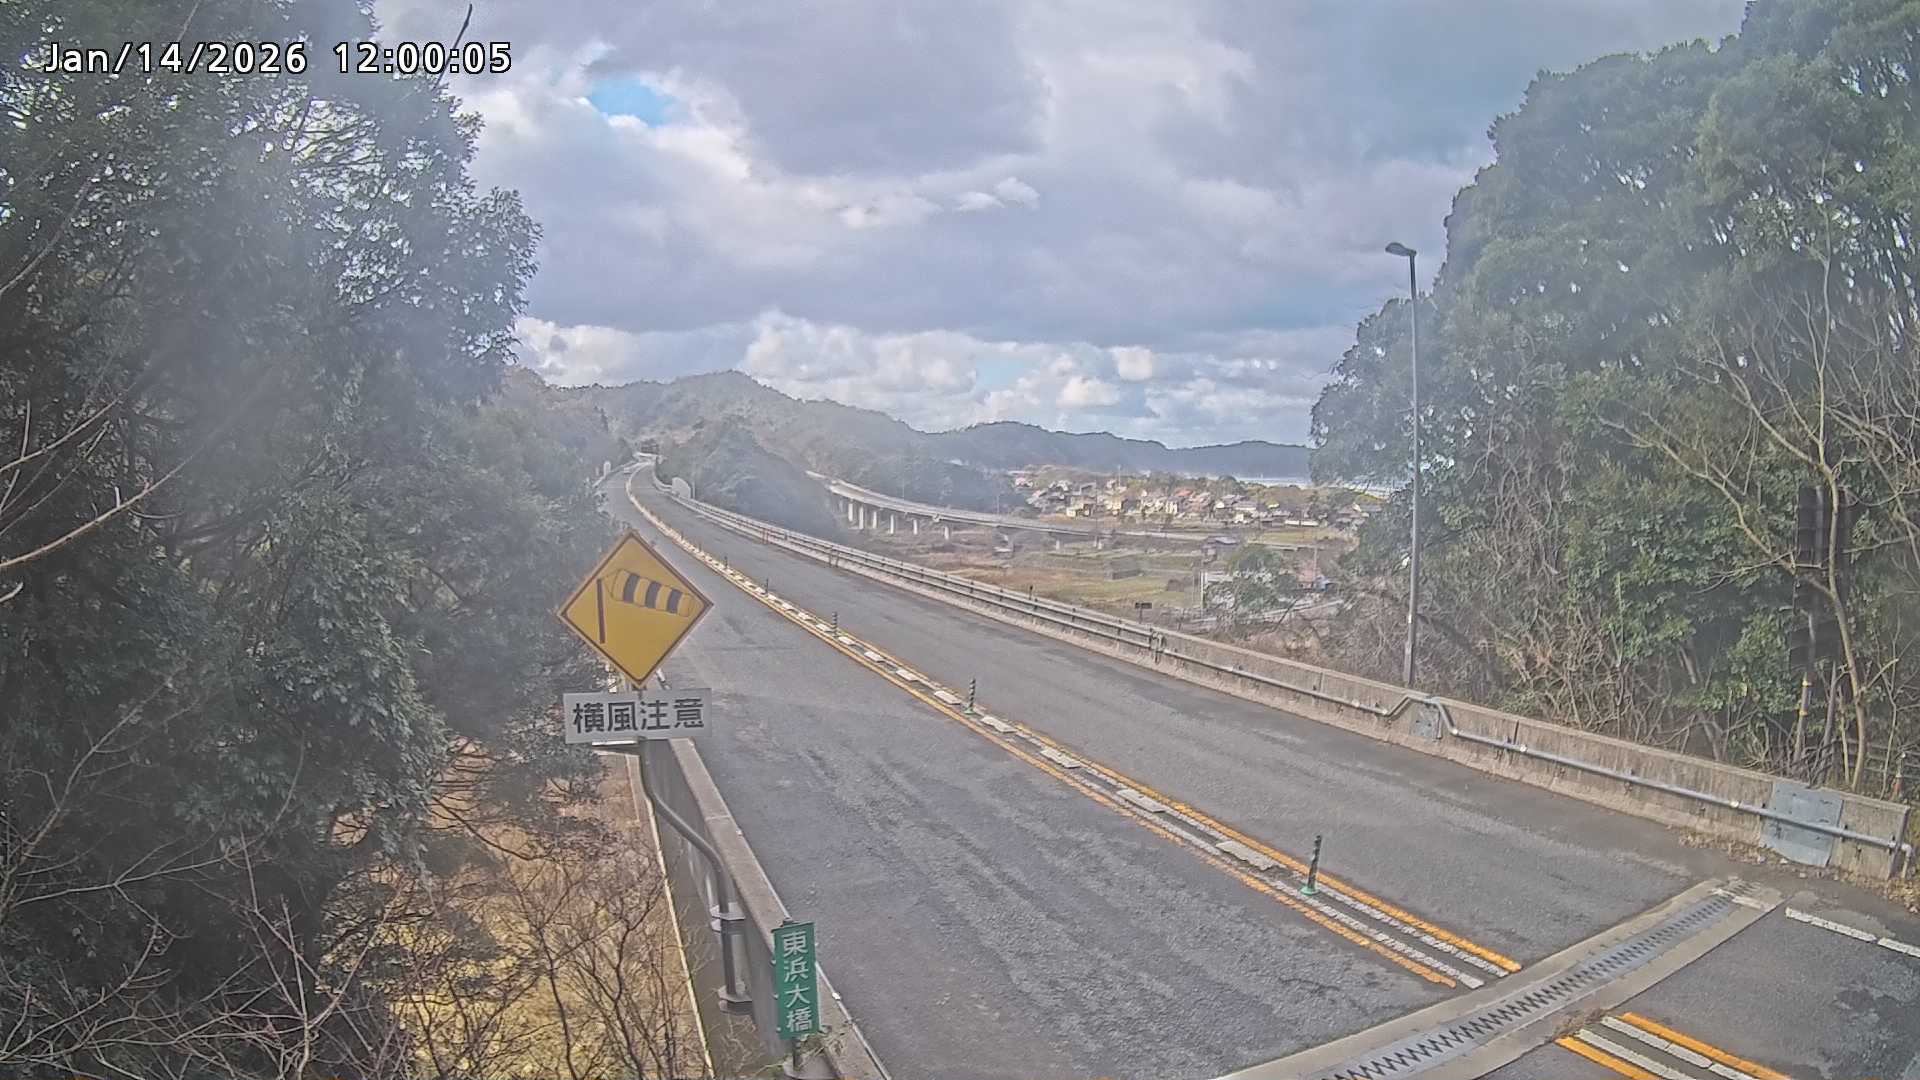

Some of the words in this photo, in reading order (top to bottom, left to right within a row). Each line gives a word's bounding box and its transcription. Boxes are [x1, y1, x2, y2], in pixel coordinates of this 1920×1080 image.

[572, 698, 705, 734] 横風注意
[781, 930, 813, 1033] 東浜大橋
